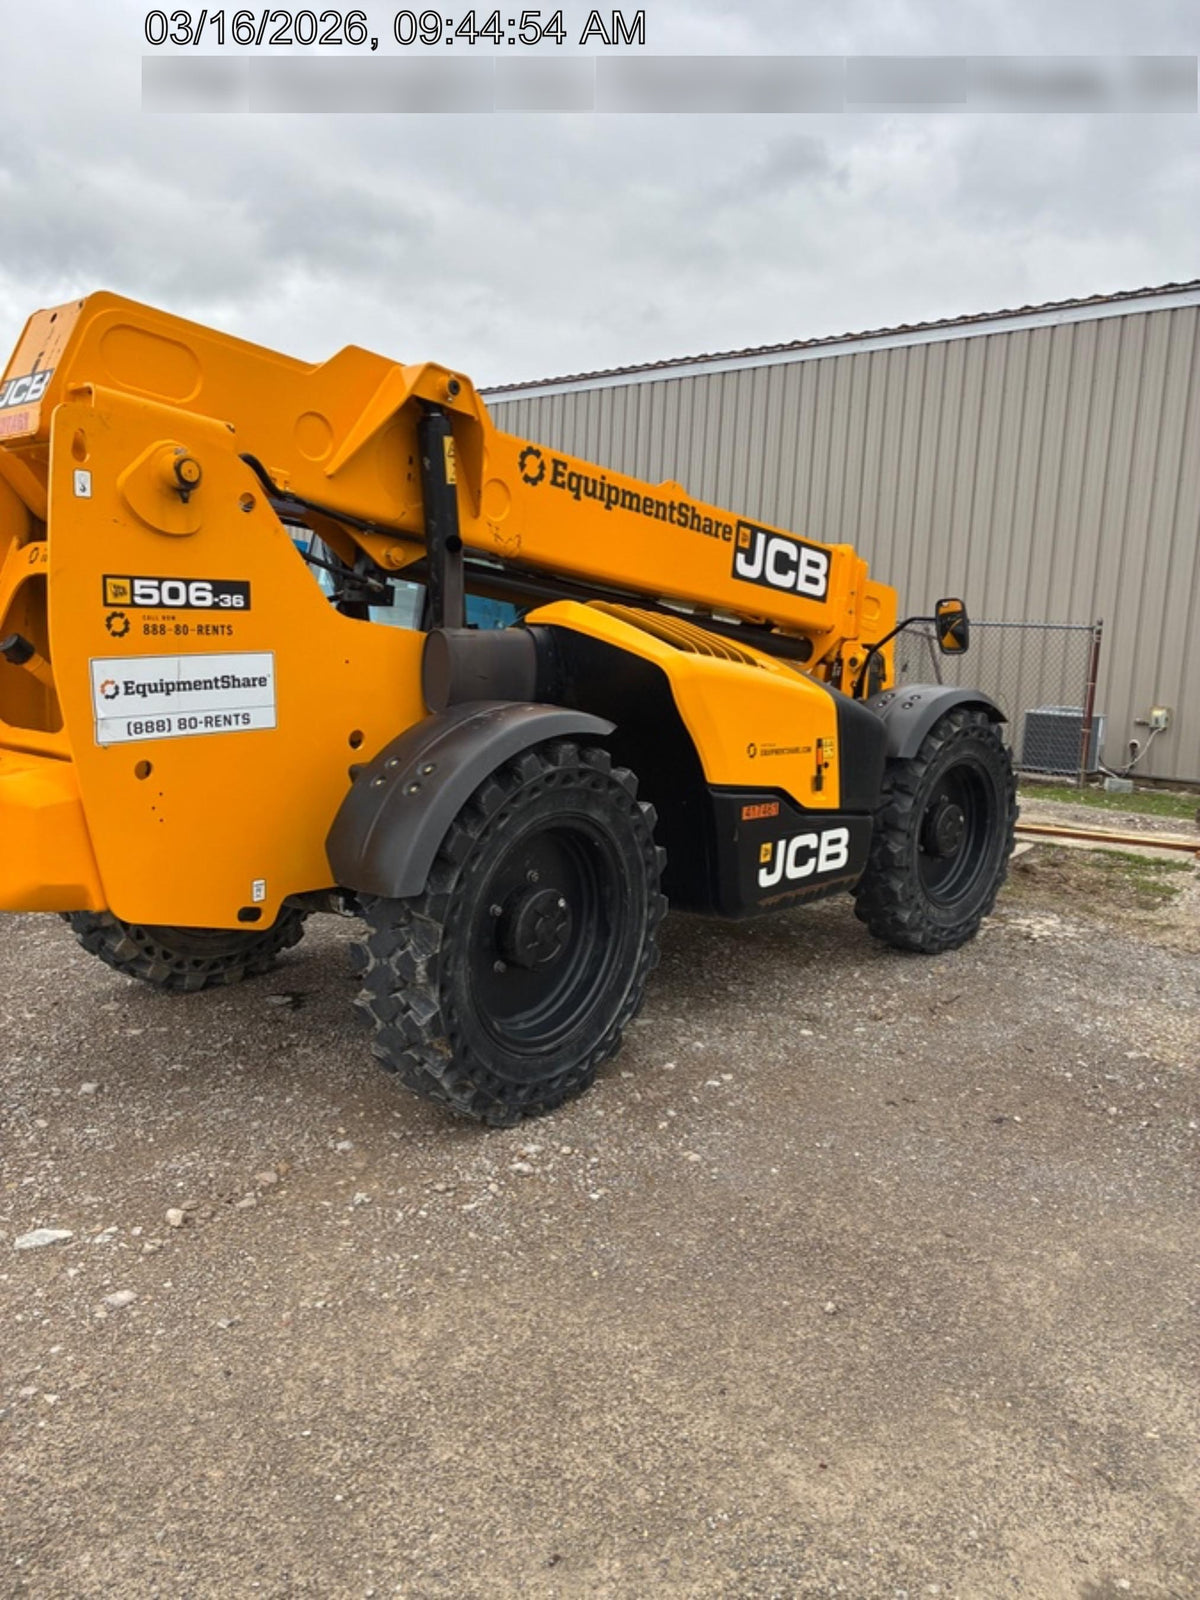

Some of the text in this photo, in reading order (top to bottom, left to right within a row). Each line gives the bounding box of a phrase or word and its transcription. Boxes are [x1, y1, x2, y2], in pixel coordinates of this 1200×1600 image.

[0, 370, 51, 408] JCB
[550, 457, 733, 543] EquipmentShare
[736, 531, 830, 598] JCB
[132, 578, 245, 608] 506-36
[142, 623, 234, 637] 888-80-RENTS
[122, 674, 268, 699] EquipmentShare
[127, 712, 251, 737] (888) 80-RENTS
[758, 826, 850, 888] JCB
